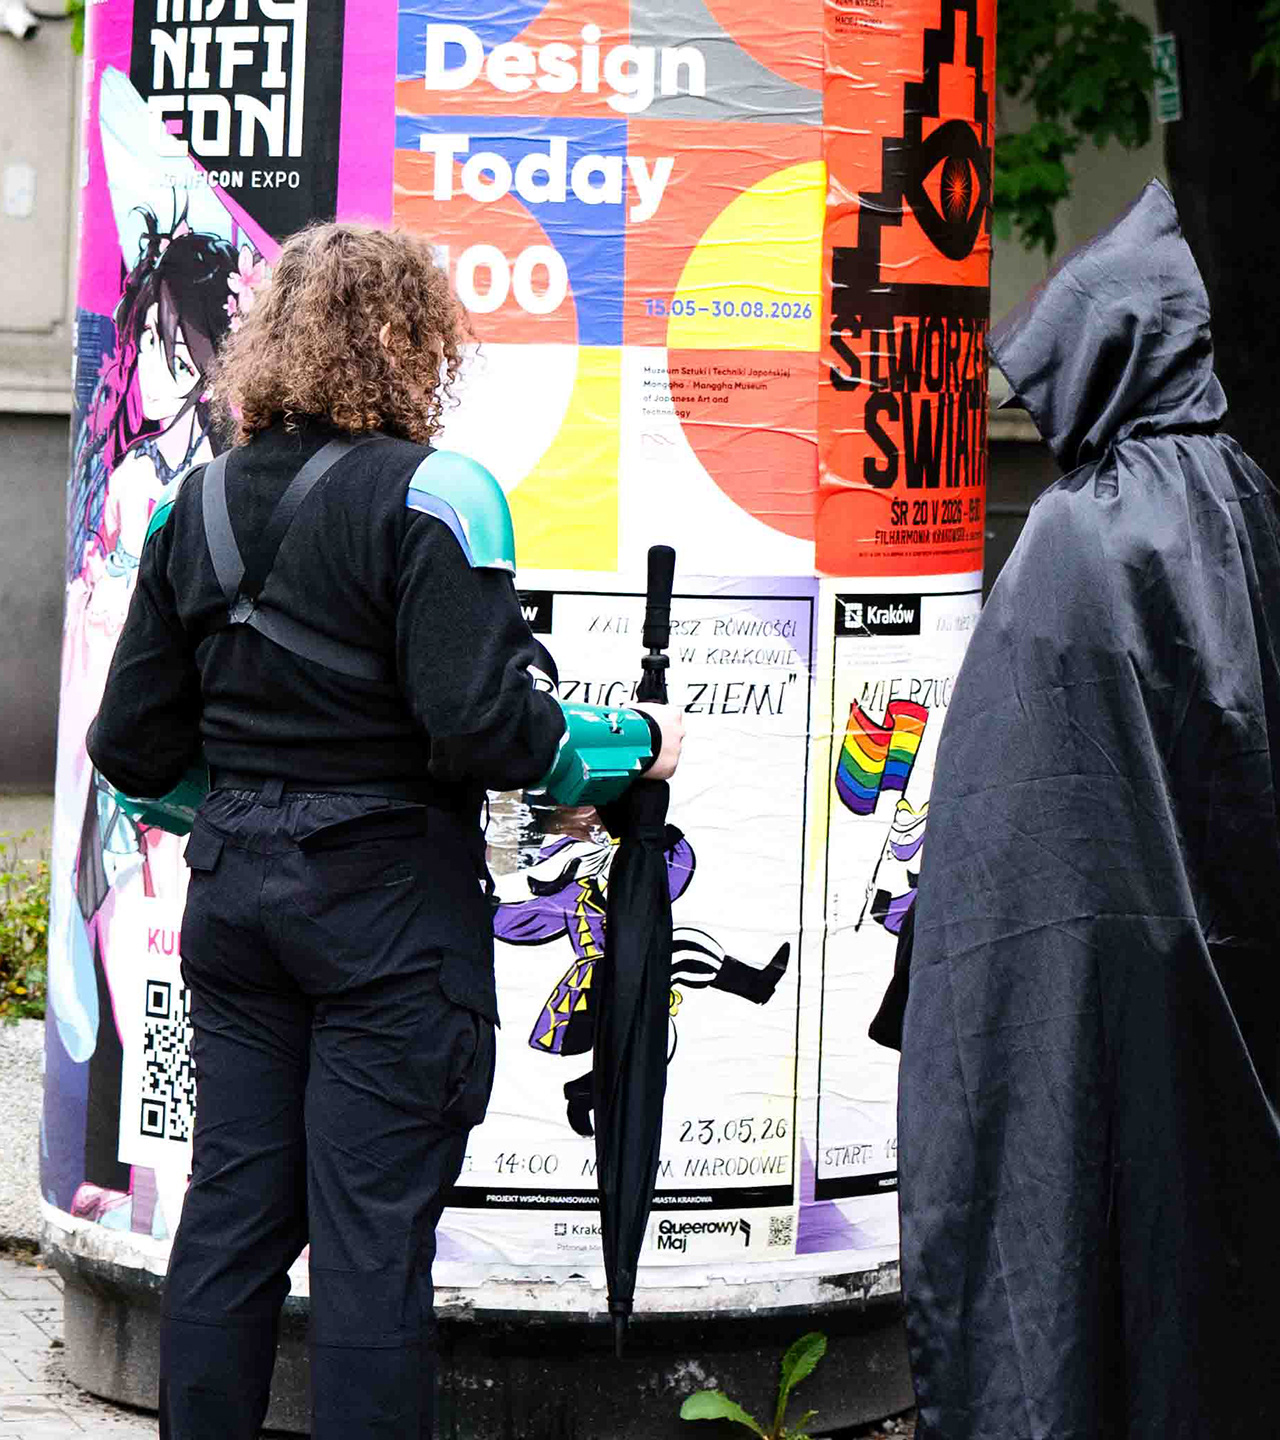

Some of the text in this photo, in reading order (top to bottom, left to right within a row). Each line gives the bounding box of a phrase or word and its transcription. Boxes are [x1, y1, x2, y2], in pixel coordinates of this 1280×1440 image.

[150, 25, 289, 90] NIFI
[424, 23, 706, 114] Design
[251, 170, 300, 189] EXPO
[419, 135, 675, 223] Today
[644, 366, 680, 375] Muzeum
[681, 366, 707, 376] Sztuki
[713, 367, 746, 376] Techniki
[747, 367, 791, 379] Japońskiej
[643, 380, 768, 392] Manggha Manggha Museum
[643, 395, 729, 405] of Japanese Art and
[642, 407, 691, 419] Technology
[891, 497, 908, 526] ŚR
[913, 500, 928, 525] 20
[931, 500, 939, 525] V
[941, 499, 963, 524] 2026
[867, 603, 915, 625] Kraków
[680, 647, 797, 666] W KRAKOWIE
[494, 1152, 559, 1174] 14:00
[684, 1155, 789, 1178] NARODOWE
[486, 1194, 518, 1203] PROJEKT
[677, 1195, 713, 1204] KRAKOWA
[658, 1219, 738, 1236] Queerowy
[657, 1235, 687, 1253] Maj
